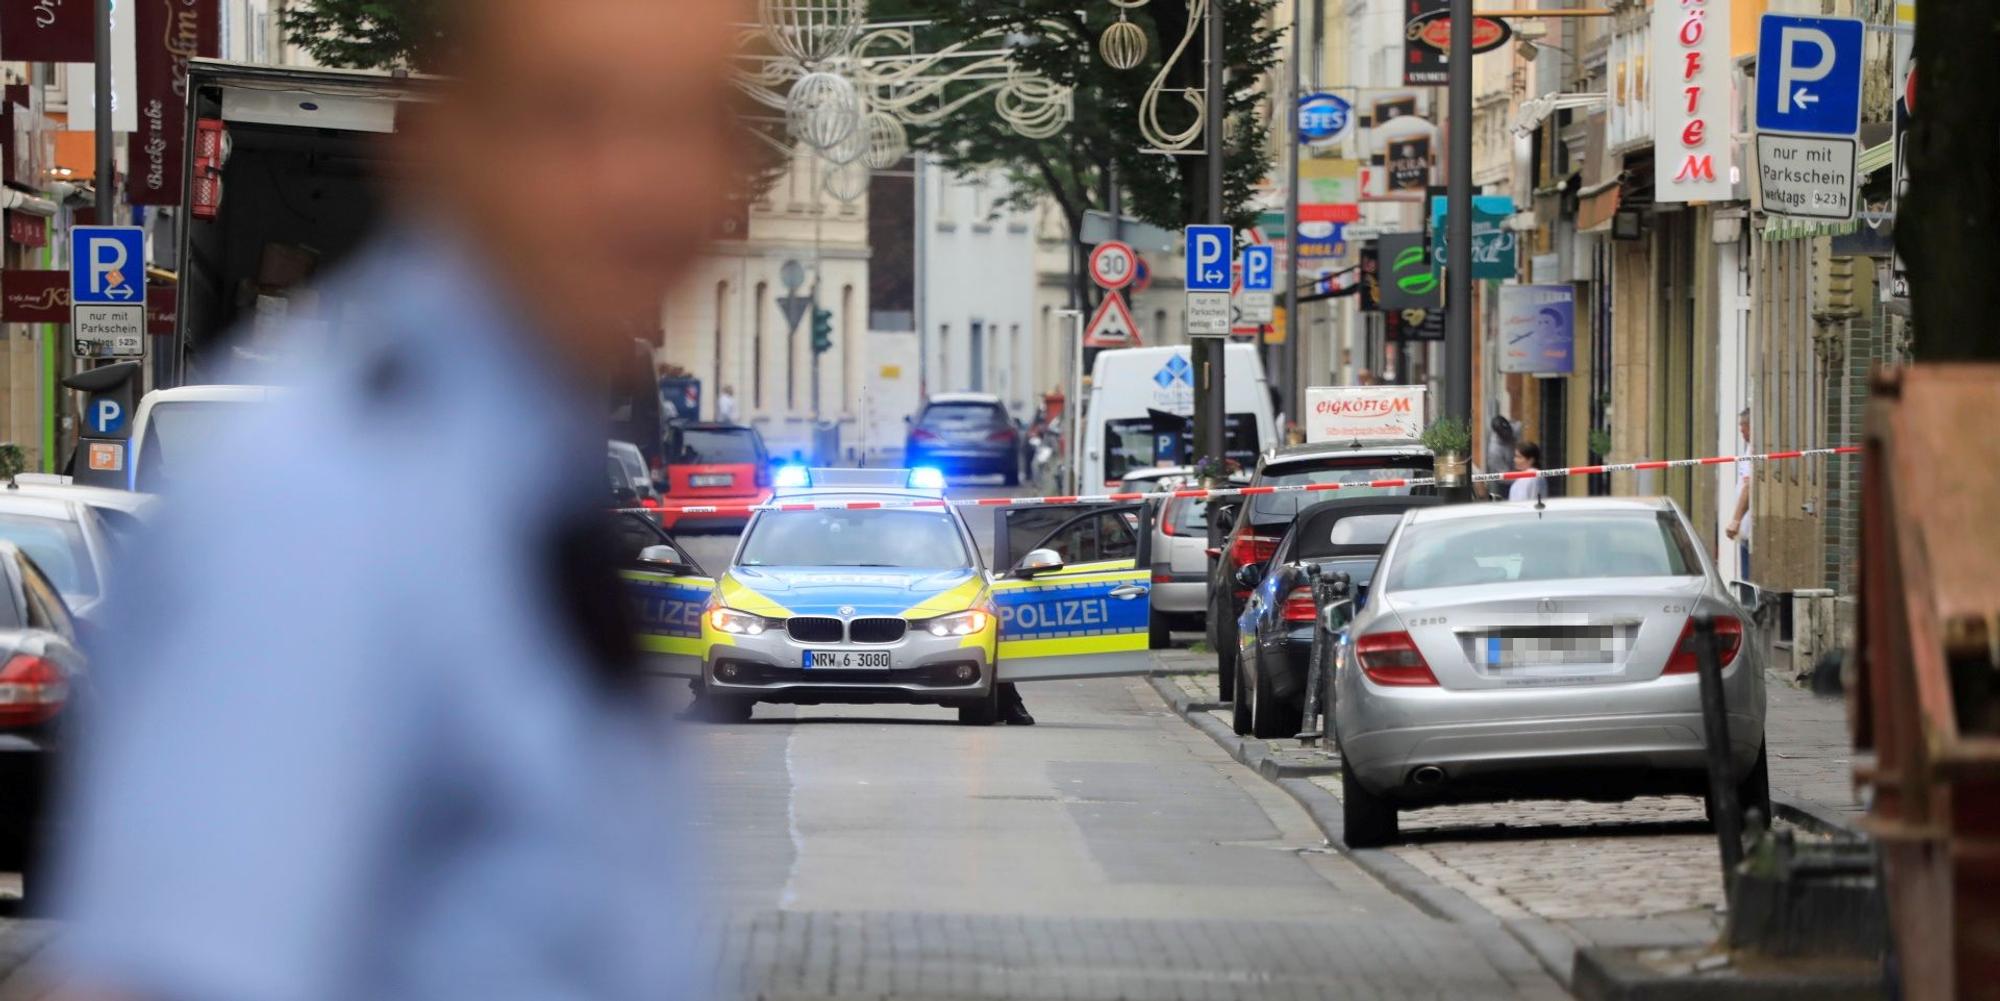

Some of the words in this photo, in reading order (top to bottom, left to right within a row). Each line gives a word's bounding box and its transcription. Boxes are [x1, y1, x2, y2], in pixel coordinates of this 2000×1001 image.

[1777, 26, 1836, 114] P
[1297, 111, 1345, 129] EFES
[1773, 147, 1798, 160] nur
[1806, 147, 1832, 162] mit
[1763, 165, 1845, 185] Parkschein
[1764, 189, 1806, 207] werktags
[89, 237, 128, 293] P
[1100, 255, 1125, 275] 30
[1196, 234, 1221, 282] P
[1249, 250, 1268, 285] P
[111, 312, 128, 320] mit
[81, 323, 137, 333] Parkschein
[99, 400, 120, 432] P
[1158, 435, 1172, 452] P
[1000, 598, 1109, 629] POLIZEI
[811, 653, 836, 667] NRW
[843, 653, 888, 667] 6-3080
